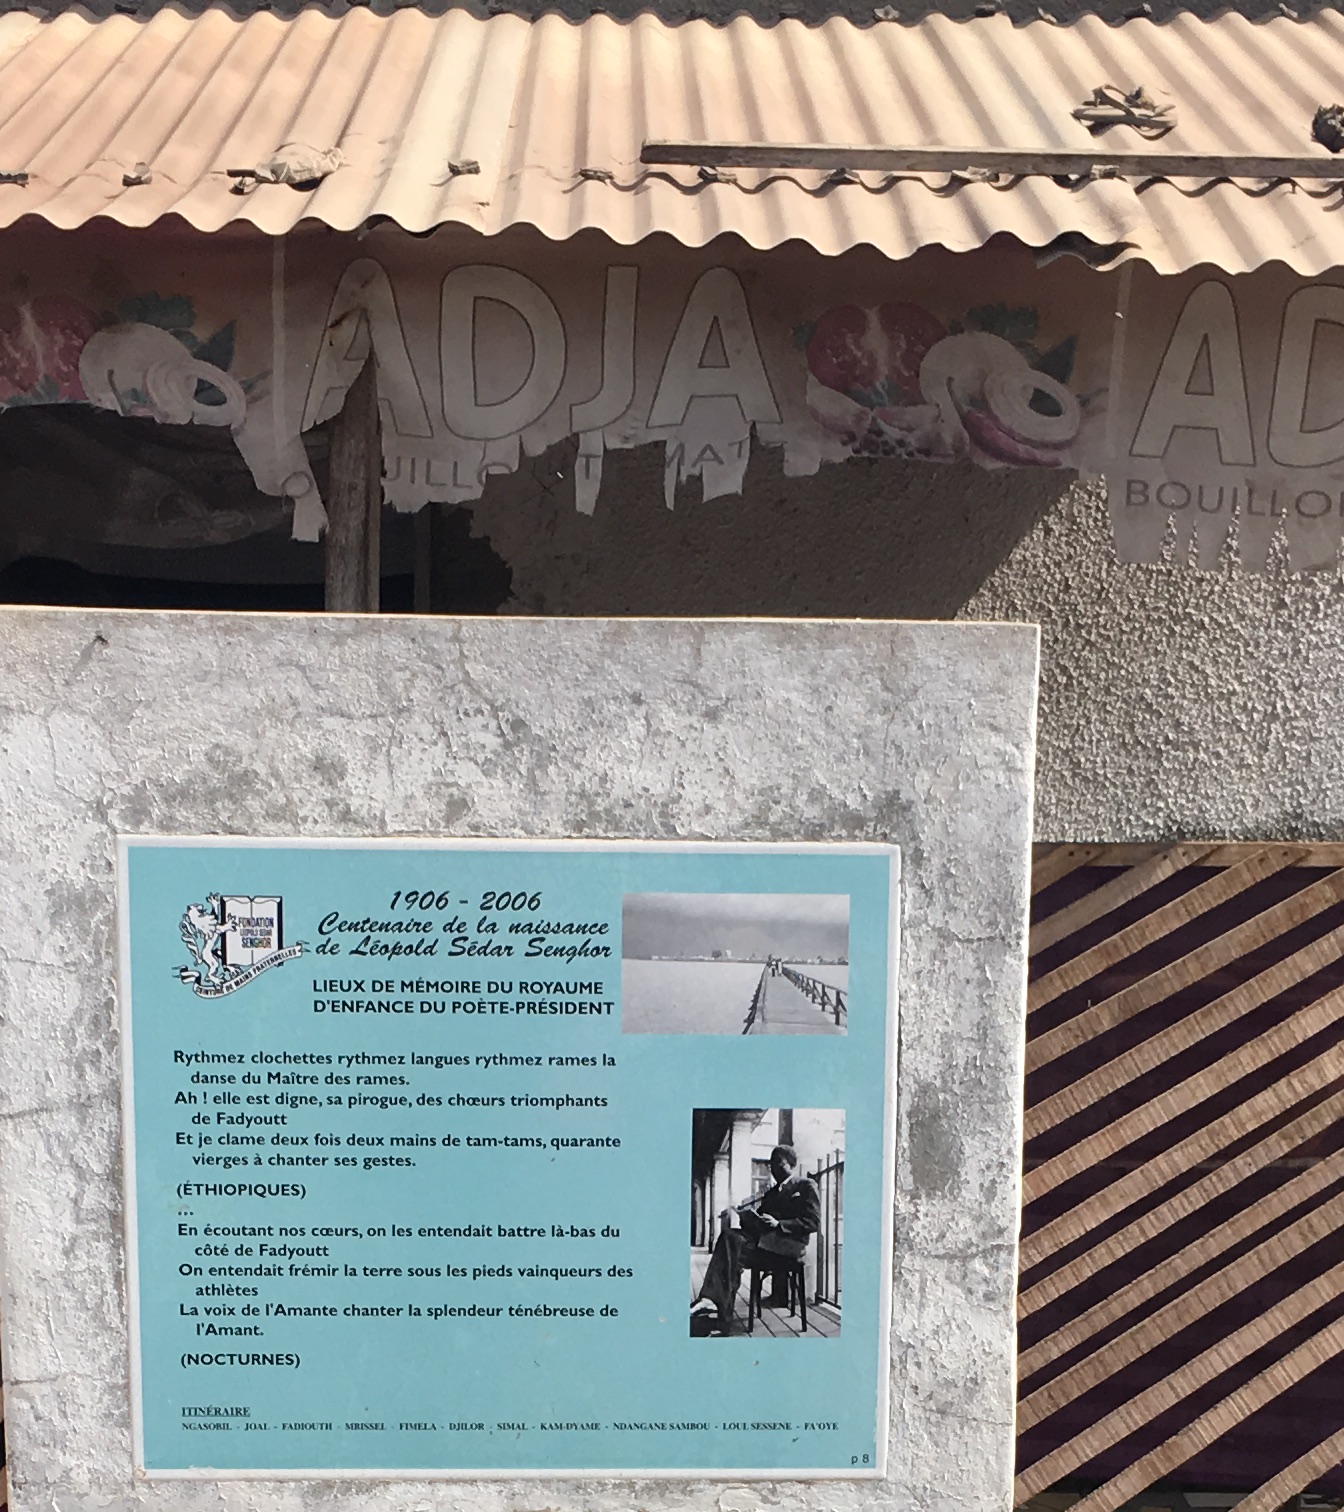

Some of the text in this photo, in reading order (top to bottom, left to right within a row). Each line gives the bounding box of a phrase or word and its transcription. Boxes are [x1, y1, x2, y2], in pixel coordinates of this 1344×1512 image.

[301, 257, 781, 442] ADJA
[389, 889, 451, 911] 1906
[478, 890, 543, 912] 2006
[317, 910, 610, 937] Centenaire de la naissance
[314, 933, 613, 965] de Léopold Sédar Senghor
[312, 976, 603, 995] LIEUX DE MÉMOIRE DU ROYAUME
[313, 997, 615, 1015] D'ENFANCE DU POÈTE-PRÉSIDENT
[173, 1049, 617, 1070] Rythmez clochettes rythmez langues rythmez rames la
[189, 1070, 410, 1086] danse du Maître des rames.
[173, 1090, 197, 1105] Ah
[212, 1090, 241, 1105] elle
[245, 1092, 271, 1105] est
[274, 1090, 323, 1109] digne,
[325, 1094, 343, 1106] sa
[347, 1091, 413, 1110] pirogue,
[415, 1091, 443, 1107] des
[447, 1092, 506, 1107] chœurs
[509, 1092, 608, 1111] triomphants
[190, 1111, 288, 1129] de Fadyoutt
[175, 1131, 621, 1151] Et je clame deux fois deux mains de tam-tams, quarante
[191, 1151, 416, 1171] vierges à chanter ses gestes.
[175, 1179, 307, 1200] (ÉTHIOPIQUES)
[177, 1222, 620, 1240] En écoutant nos cœurs, on les entendait battre là-bas du
[193, 1242, 329, 1261] côté de Fadyoutt
[177, 1262, 633, 1281] On entendait frémir la terre sous les pieds vainqueurs des
[195, 1282, 259, 1297] athlètes
[179, 1302, 619, 1321] La voix de l'Amante chanter la splendeur ténébreuse de
[195, 1321, 265, 1336] l'Amant.
[180, 1352, 301, 1369] (NOCTURNES)
[181, 1403, 251, 1418] ITINÉRAIRE
[244, 1421, 270, 1431] JOAL
[282, 1421, 333, 1431] FADIOUTH
[399, 1421, 437, 1431] FIMELA
[497, 1421, 529, 1431] SIMAL
[613, 1421, 667, 1431] NDANGANE
[669, 1421, 711, 1431] SAMBOU
[850, 1452, 870, 1466] p 8
